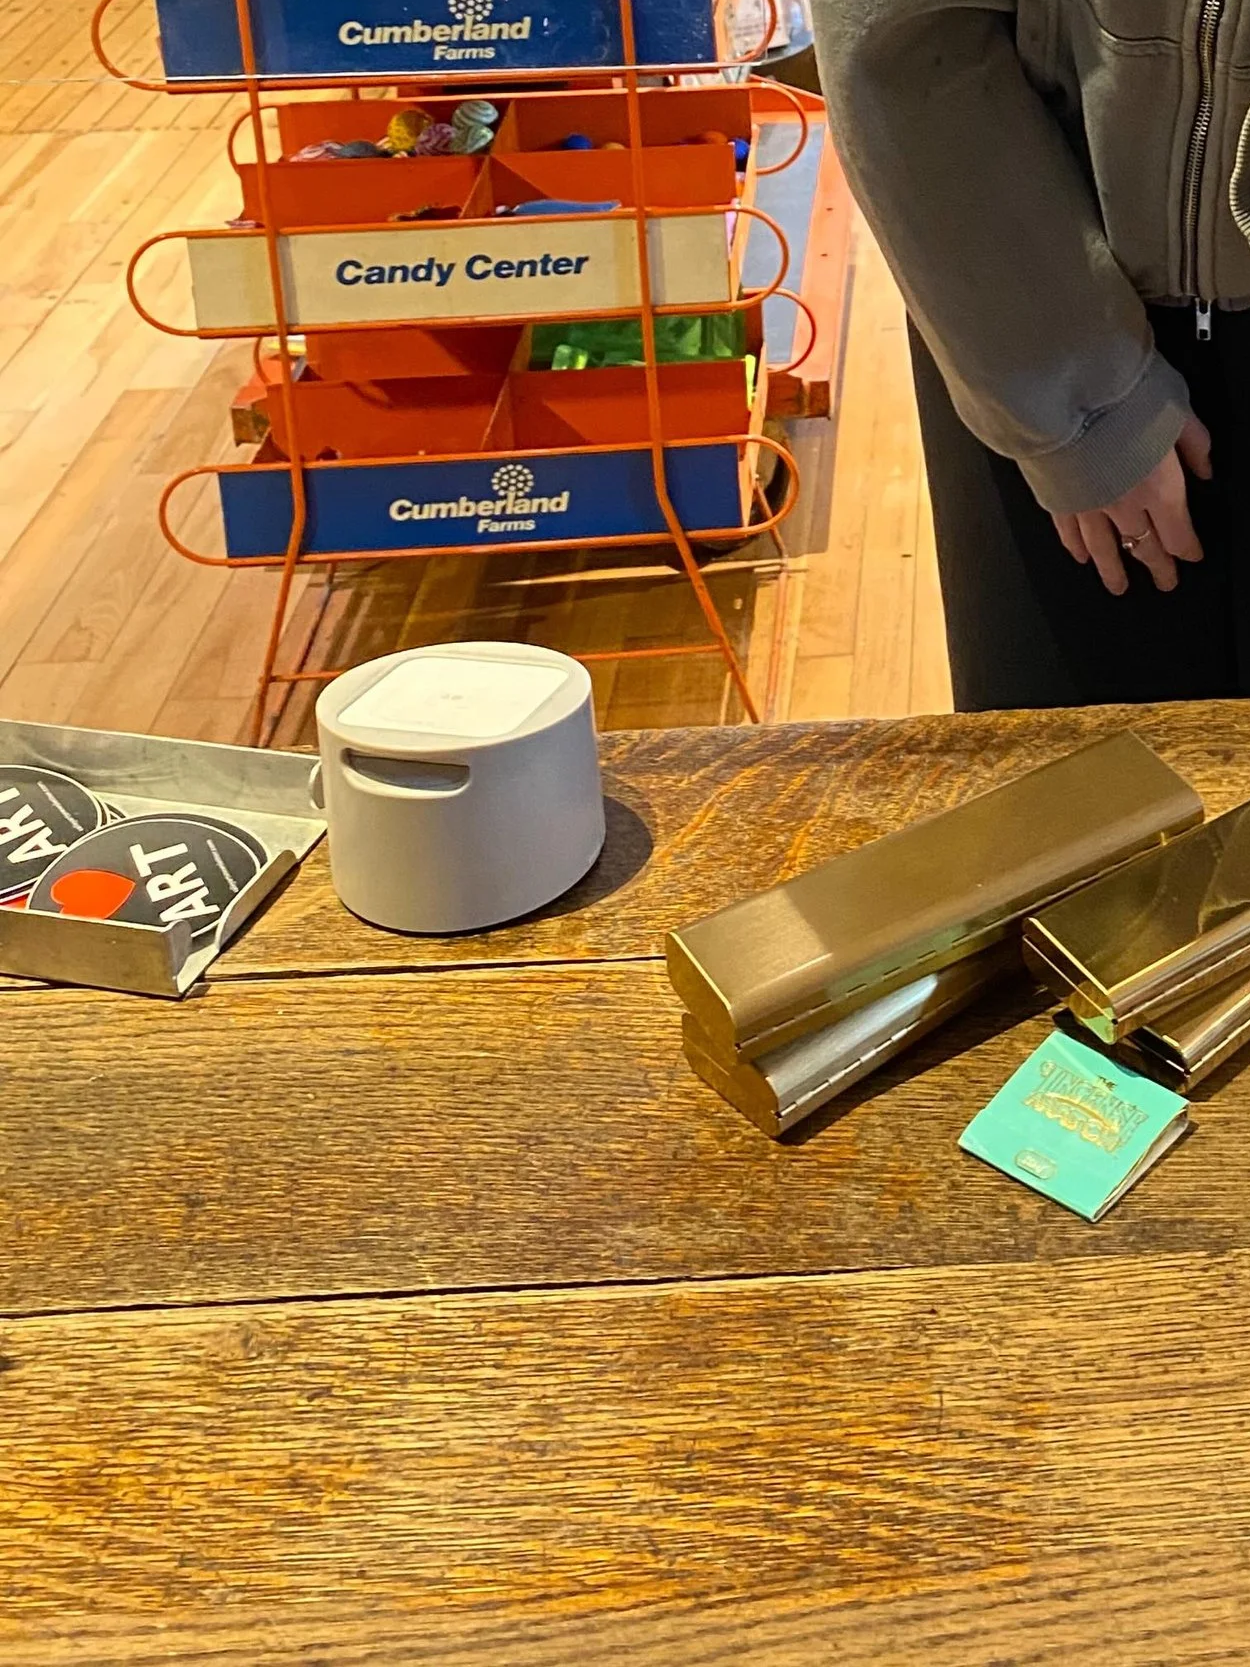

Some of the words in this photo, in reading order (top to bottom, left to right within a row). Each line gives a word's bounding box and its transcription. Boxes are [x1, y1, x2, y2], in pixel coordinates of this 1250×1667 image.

[338, 16, 532, 45] Cumberland
[433, 45, 495, 61] Farms
[336, 257, 455, 287] Candy
[465, 253, 589, 280] Center
[389, 491, 570, 521] Cumberland
[477, 518, 535, 533] Farms
[0, 787, 69, 864] AR
[129, 842, 220, 922] ART
[1040, 1061, 1150, 1146] INCENSE
